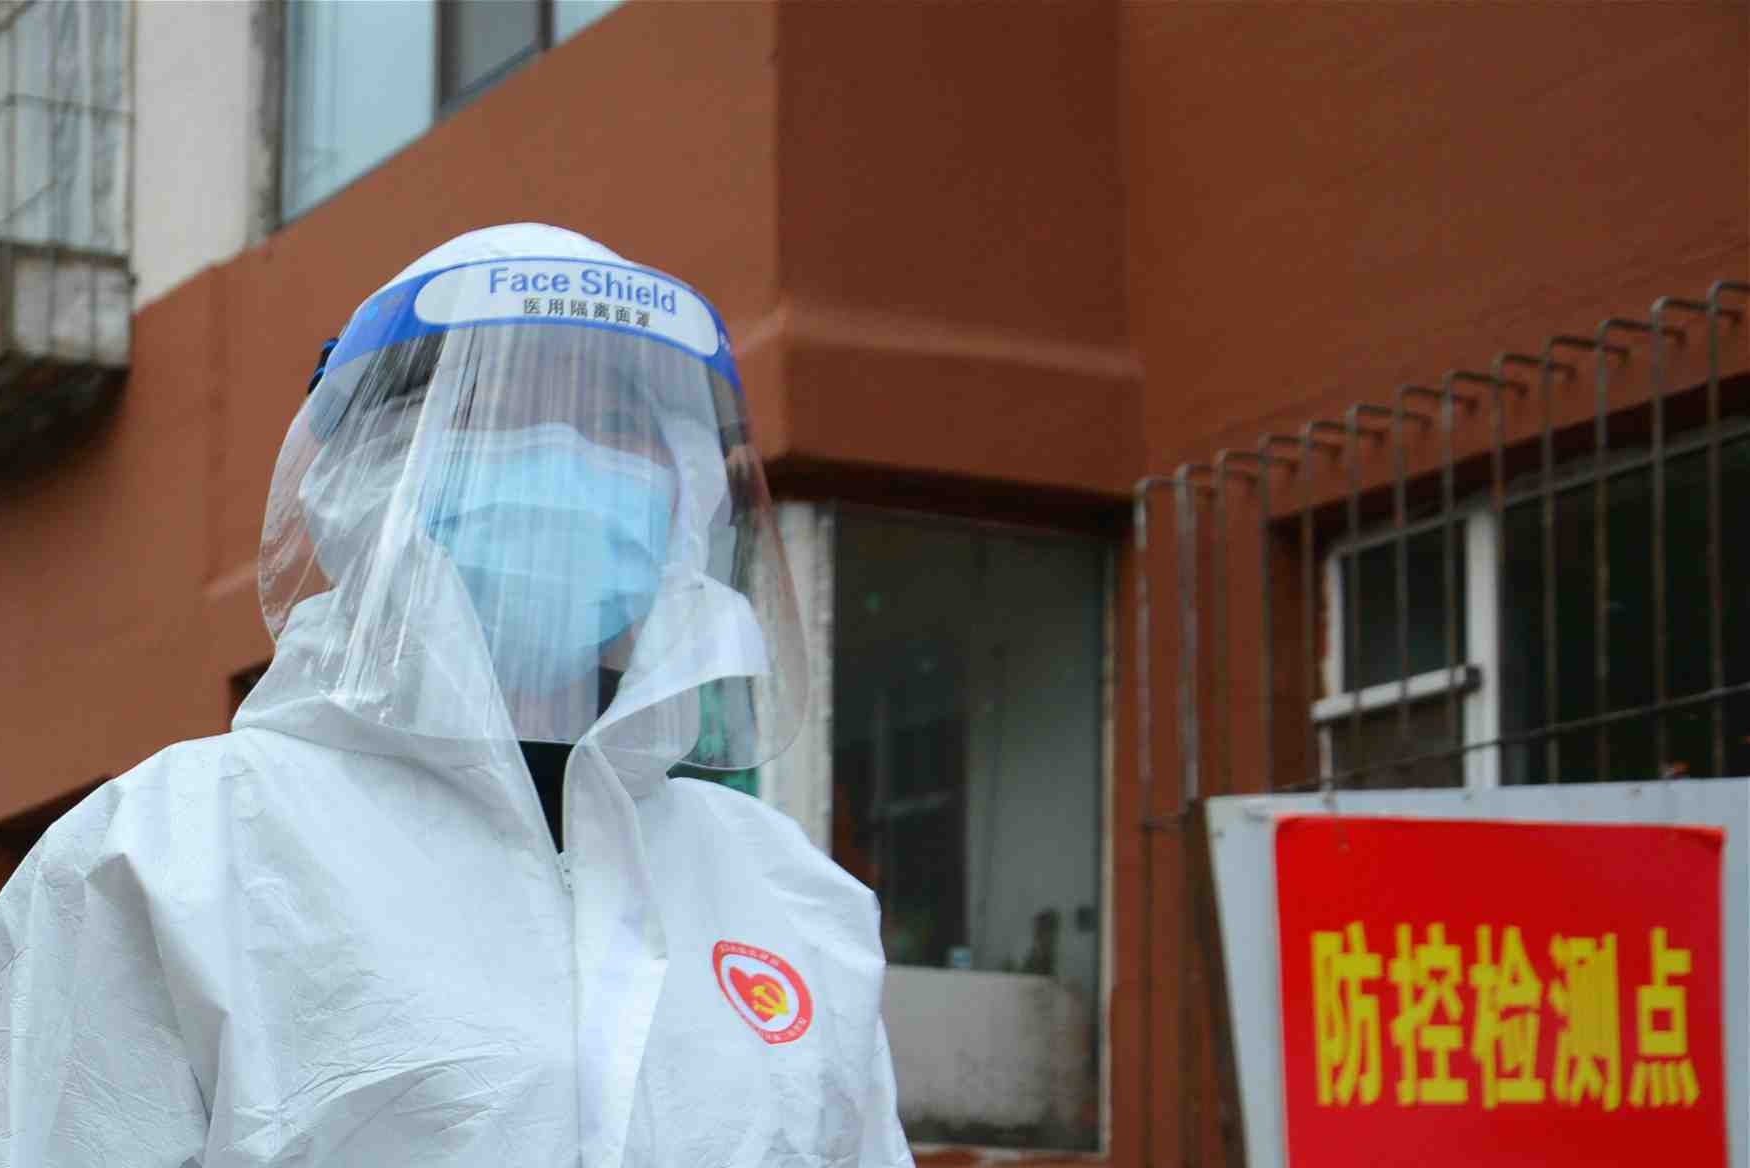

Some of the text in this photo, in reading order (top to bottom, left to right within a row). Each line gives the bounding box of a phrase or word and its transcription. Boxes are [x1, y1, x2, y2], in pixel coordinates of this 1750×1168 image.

[488, 266, 677, 315] Face Shield
[522, 297, 651, 329] 医用隔离面罩
[1311, 921, 1700, 1111] 防控检测点
